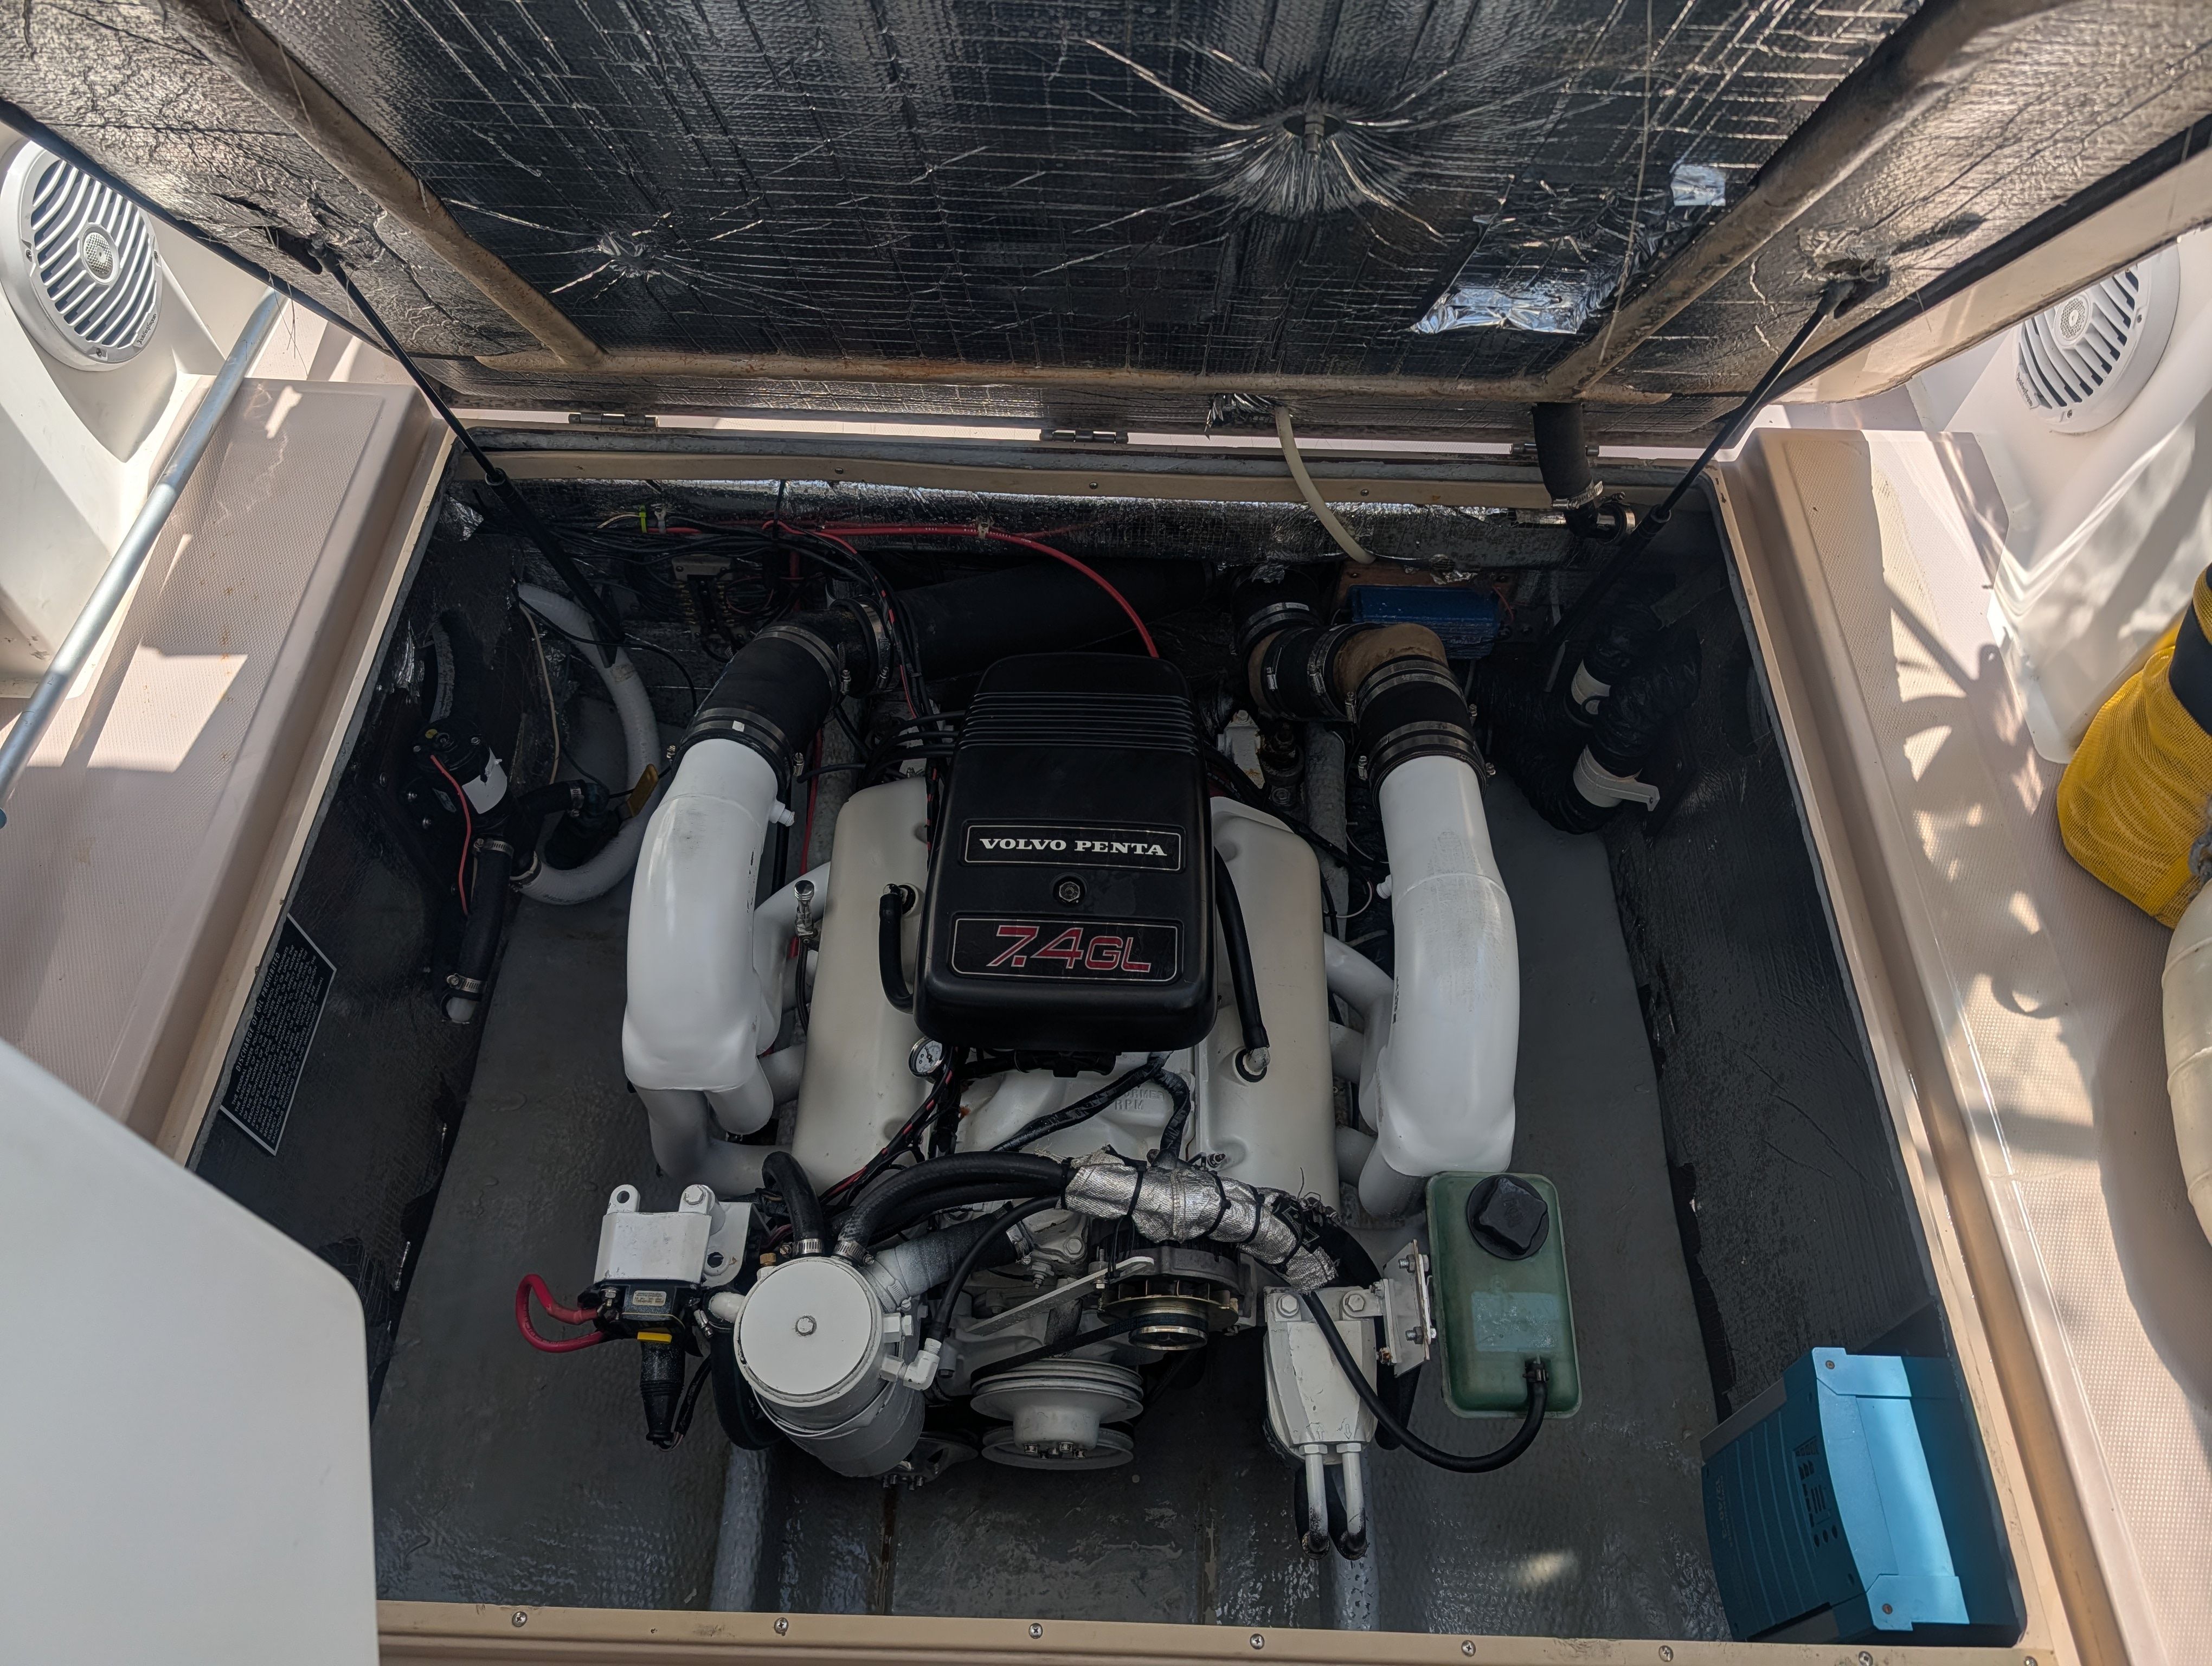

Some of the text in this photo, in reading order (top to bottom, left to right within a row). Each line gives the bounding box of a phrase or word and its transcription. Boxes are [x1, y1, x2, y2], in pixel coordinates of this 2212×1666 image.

[979, 838, 1167, 856] VOLVO PENTA
[235, 952, 280, 1072] DISCHARGE OF OIL PROHIBITED
[986, 925, 1152, 973] 7.4GL
[236, 1068, 247, 1093] FEDERAL
[245, 1047, 254, 1066] WATER
[252, 1015, 265, 1046] POLLUTION
[263, 988, 275, 1014] CONTROL
[277, 946, 289, 973] PROHIBITS
[239, 1083, 252, 1116] NAVIGABLE
[250, 1059, 260, 1081] WATERS
[259, 1049, 263, 1058] OF
[266, 1016, 275, 1036] UNITED
[281, 983, 286, 992] OR
[288, 950, 298, 970] WATERS
[239, 1066, 253, 1100] DISCHARGE
[251, 1055, 256, 1065] OF
[259, 1034, 263, 1043] OR
[266, 999, 275, 1018] WASTE
[279, 974, 284, 983] OR
[243, 1110, 248, 1120] OF
[251, 1057, 266, 1096] CONTIGUOUS
[271, 1027, 276, 1036] OR
[275, 1006, 284, 1025] WHICH
[287, 971, 295, 991] AFFECT
[294, 947, 304, 971] NATURAL
[247, 1090, 260, 1123] RESOURCES
[259, 1054, 272, 1088] BELONGING
[292, 981, 297, 990] OR
[295, 962, 304, 980] UNDER
[251, 1097, 263, 1127] EXCLUSIVE
[261, 1053, 277, 1095] MANAGEMENT
[276, 1022, 288, 1053] AUTHORITY
[287, 1012, 291, 1021] OF
[294, 980, 303, 999] UNITED
[259, 1108, 270, 1134] SURFACE
[268, 1098, 273, 1107] OF
[275, 1066, 284, 1084] WATER
[282, 1055, 287, 1064] OR
[286, 1033, 295, 1054] CAUSES
[295, 1003, 305, 1025] SLUDGE
[303, 994, 308, 1003] OR
[263, 1073, 276, 1106] DISCHARGE
[274, 1050, 284, 1072] CAUSES
[290, 1019, 294, 1028] OR
[292, 975, 310, 1018] DISCOLORATION
[307, 966, 312, 974] OF
[267, 1116, 277, 1140] SUBJECT
[275, 1107, 280, 1115] TO
[278, 1071, 293, 1106] SUBSTANTIAL
[305, 1002, 315, 1026] AND/OR
[263, 1111, 274, 1137] BENEATH
[276, 1073, 287, 1098] SURFACE
[285, 1062, 289, 1072] OF
[271, 1110, 284, 1144] SANCTIONS
[282, 1078, 294, 1108] INCLUDING
[1115, 1099, 1144, 1110] RPM
